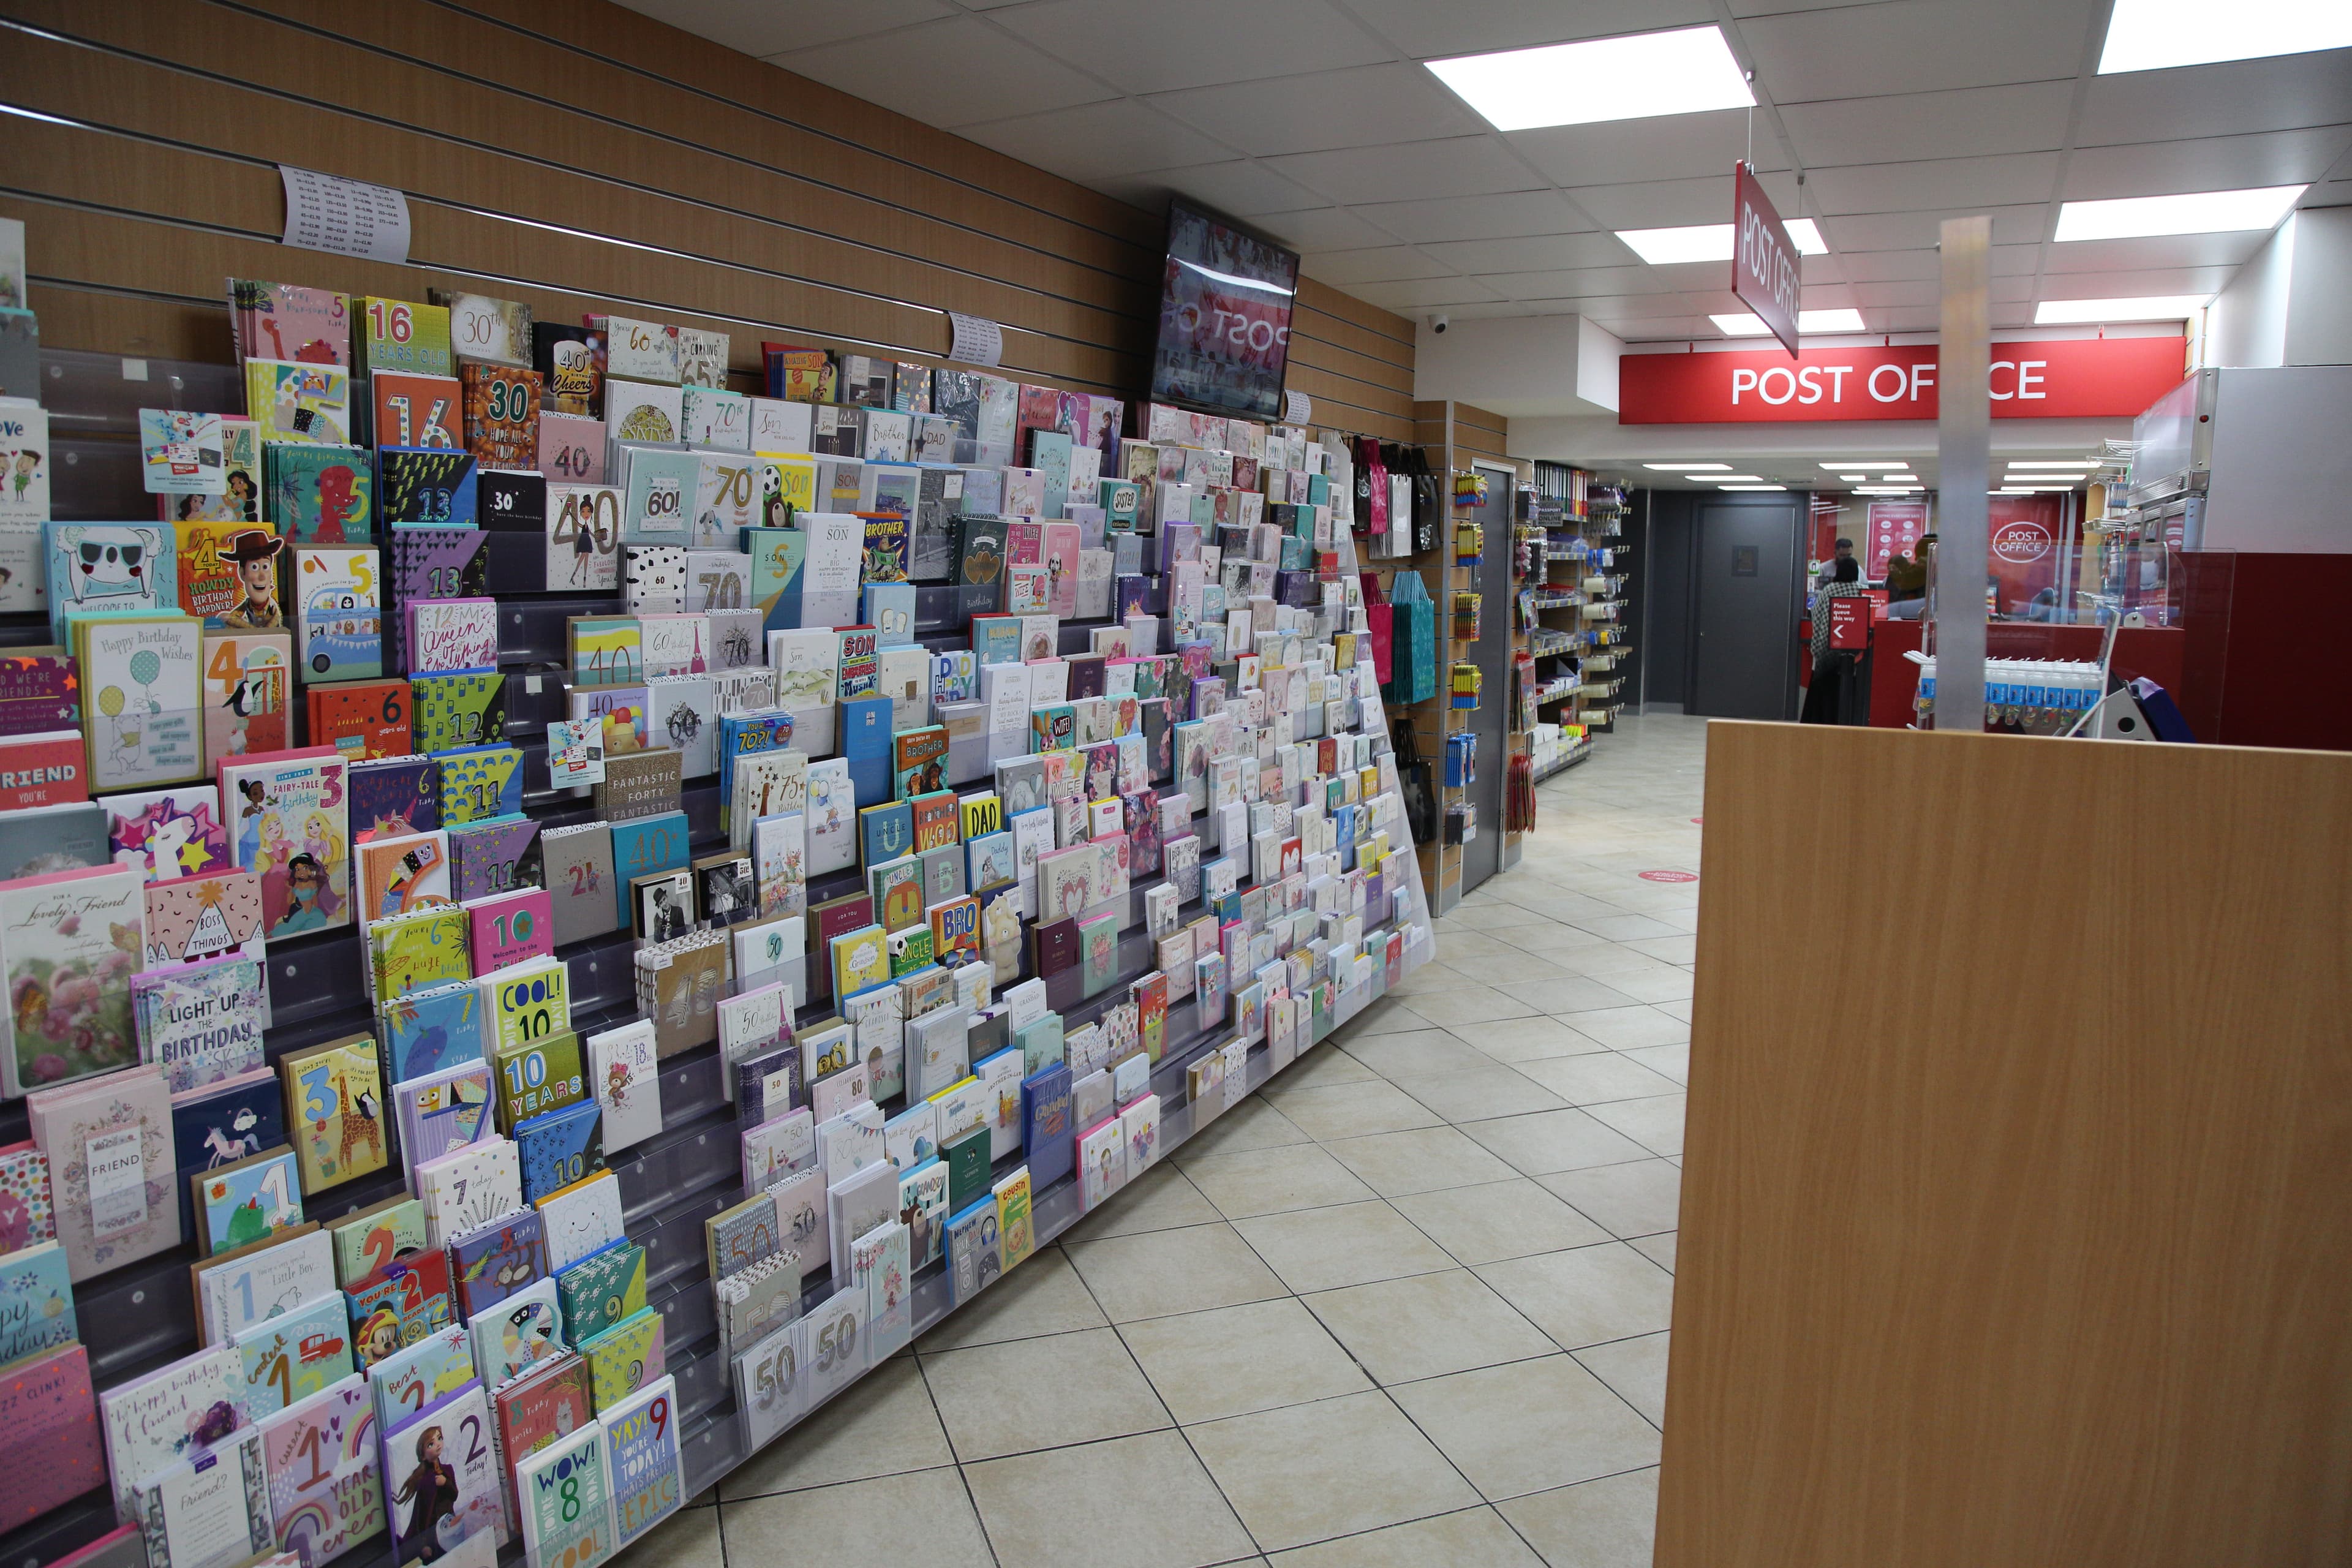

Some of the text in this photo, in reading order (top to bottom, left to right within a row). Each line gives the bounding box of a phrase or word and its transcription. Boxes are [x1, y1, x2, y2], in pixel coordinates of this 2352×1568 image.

[1742, 200, 1801, 335] POST OFFICE
[331, 295, 345, 318] 5
[368, 300, 413, 344] 16
[629, 325, 654, 352] 60
[369, 342, 448, 366] YEARS OLD
[784, 353, 824, 369] AMAZING SON
[549, 374, 595, 397] Cheers
[1732, 360, 2047, 405] POST OFCE
[489, 380, 529, 424] 30
[386, 393, 454, 448] 16
[872, 423, 907, 442] Brother
[489, 426, 523, 444] HOPE ALL
[925, 432, 946, 446] DAD
[230, 429, 257, 469] 4
[494, 443, 515, 460] YOUR
[553, 445, 592, 478] 40
[712, 464, 754, 509] 70
[837, 472, 859, 488] SON
[418, 488, 453, 522] 13
[493, 491, 514, 511] 30
[647, 491, 681, 517] 60!
[1114, 492, 1136, 509] SISTER
[826, 528, 850, 541] SON
[865, 518, 905, 539] BROTHER
[2008, 531, 2040, 541] POST
[192, 538, 221, 577] 4
[764, 553, 786, 562] SON
[1999, 541, 2041, 552] OFFICE
[347, 553, 373, 595] 5
[429, 565, 464, 600] 13
[655, 576, 665, 585] 60
[191, 590, 234, 606] BIRTHDAY
[698, 571, 742, 612] 70
[967, 592, 993, 608] Birthday
[195, 600, 235, 616] PARDNER!
[101, 628, 182, 655] Happy Birthday
[161, 646, 194, 662] Wishes
[842, 633, 877, 657] SON,
[15, 671, 51, 684] WE'RE
[206, 639, 244, 696] 4
[588, 645, 633, 684] 40
[841, 661, 878, 681] EMBARRASS
[940, 655, 971, 679] DAD
[381, 689, 402, 724] 6
[589, 695, 613, 716] 40
[750, 687, 765, 705] 70
[379, 723, 407, 737] years old
[448, 710, 484, 744] 12
[1052, 714, 1071, 736] WIFE!
[737, 726, 771, 753] 70?!
[906, 740, 944, 758] BROTHER
[273, 778, 320, 794] FAIRY-TALE
[319, 763, 344, 809] 3
[418, 766, 429, 795] 6
[612, 771, 676, 790] FANTASTIC
[1050, 779, 1082, 801] WIFE
[18, 789, 48, 804] YOU'RE
[280, 790, 320, 812] birthday
[470, 778, 502, 816] 11
[628, 788, 665, 803] FORTY
[918, 802, 957, 825] BROTHER
[971, 803, 997, 837] DAD
[876, 823, 907, 837] UNCLE
[628, 827, 671, 872] 40
[990, 844, 1010, 857] Daddy
[486, 858, 517, 893] 11
[677, 875, 688, 887] 40
[888, 864, 914, 885] UNCLE
[72, 888, 134, 916] Friend
[199, 912, 222, 932] BOSS
[429, 918, 443, 946] 6
[492, 909, 535, 948] 10
[942, 902, 978, 942] BRO
[191, 933, 229, 951] THINGS
[492, 943, 538, 959] Welcome to the
[766, 938, 782, 956] 50
[899, 937, 931, 964] UNCLE
[851, 954, 876, 969] Grandson
[502, 973, 561, 1014] COOL!
[1018, 993, 1040, 1006] GRANDAD
[168, 991, 241, 1024] LIGHT UP
[458, 992, 475, 1023] 7
[197, 1018, 214, 1031] THE
[518, 1008, 551, 1042] 10
[161, 1022, 255, 1063] BIRTHDAY
[504, 1049, 548, 1095] 10
[771, 1079, 782, 1090] 50
[299, 1065, 339, 1123] 3
[510, 1075, 582, 1116] YEARS
[908, 1120, 935, 1141] Grandson
[91, 1153, 141, 1177] FRIEND
[551, 1150, 587, 1189] 10
[453, 1168, 500, 1206] 7 today!
[916, 1174, 948, 1199] GRANDSON
[1002, 1180, 1027, 1201] COUSIN
[501, 1227, 514, 1253] 8
[953, 1217, 978, 1240] NEPHEW
[731, 1223, 772, 1265] 50
[271, 1268, 296, 1286] Little
[232, 1270, 255, 1322] 1
[356, 1268, 422, 1314] YOU'RE 2
[603, 1292, 624, 1328] 9
[815, 1311, 857, 1375] 50
[388, 1363, 419, 1396] Best
[624, 1359, 644, 1395] 9
[755, 1343, 796, 1411] 50
[508, 1399, 526, 1428] 8
[611, 1396, 668, 1451] YAY! 9
[458, 1414, 488, 1467] 2
[620, 1433, 650, 1460] YOU'RE
[296, 1425, 332, 1493] 1
[464, 1454, 489, 1478] Today!
[537, 1439, 595, 1493] WOW!
[621, 1441, 666, 1482] TODAY!
[330, 1463, 375, 1499] YEAR
[587, 1461, 598, 1510] TODAY!
[617, 1460, 673, 1501] THAT'S PRETTY
[339, 1487, 375, 1521] OLD
[560, 1476, 581, 1523] 8
[624, 1475, 674, 1528] EPIC
[543, 1496, 556, 1532] YOU'RE
[568, 1503, 609, 1533] TOTALLY
[322, 1506, 382, 1555] ever
